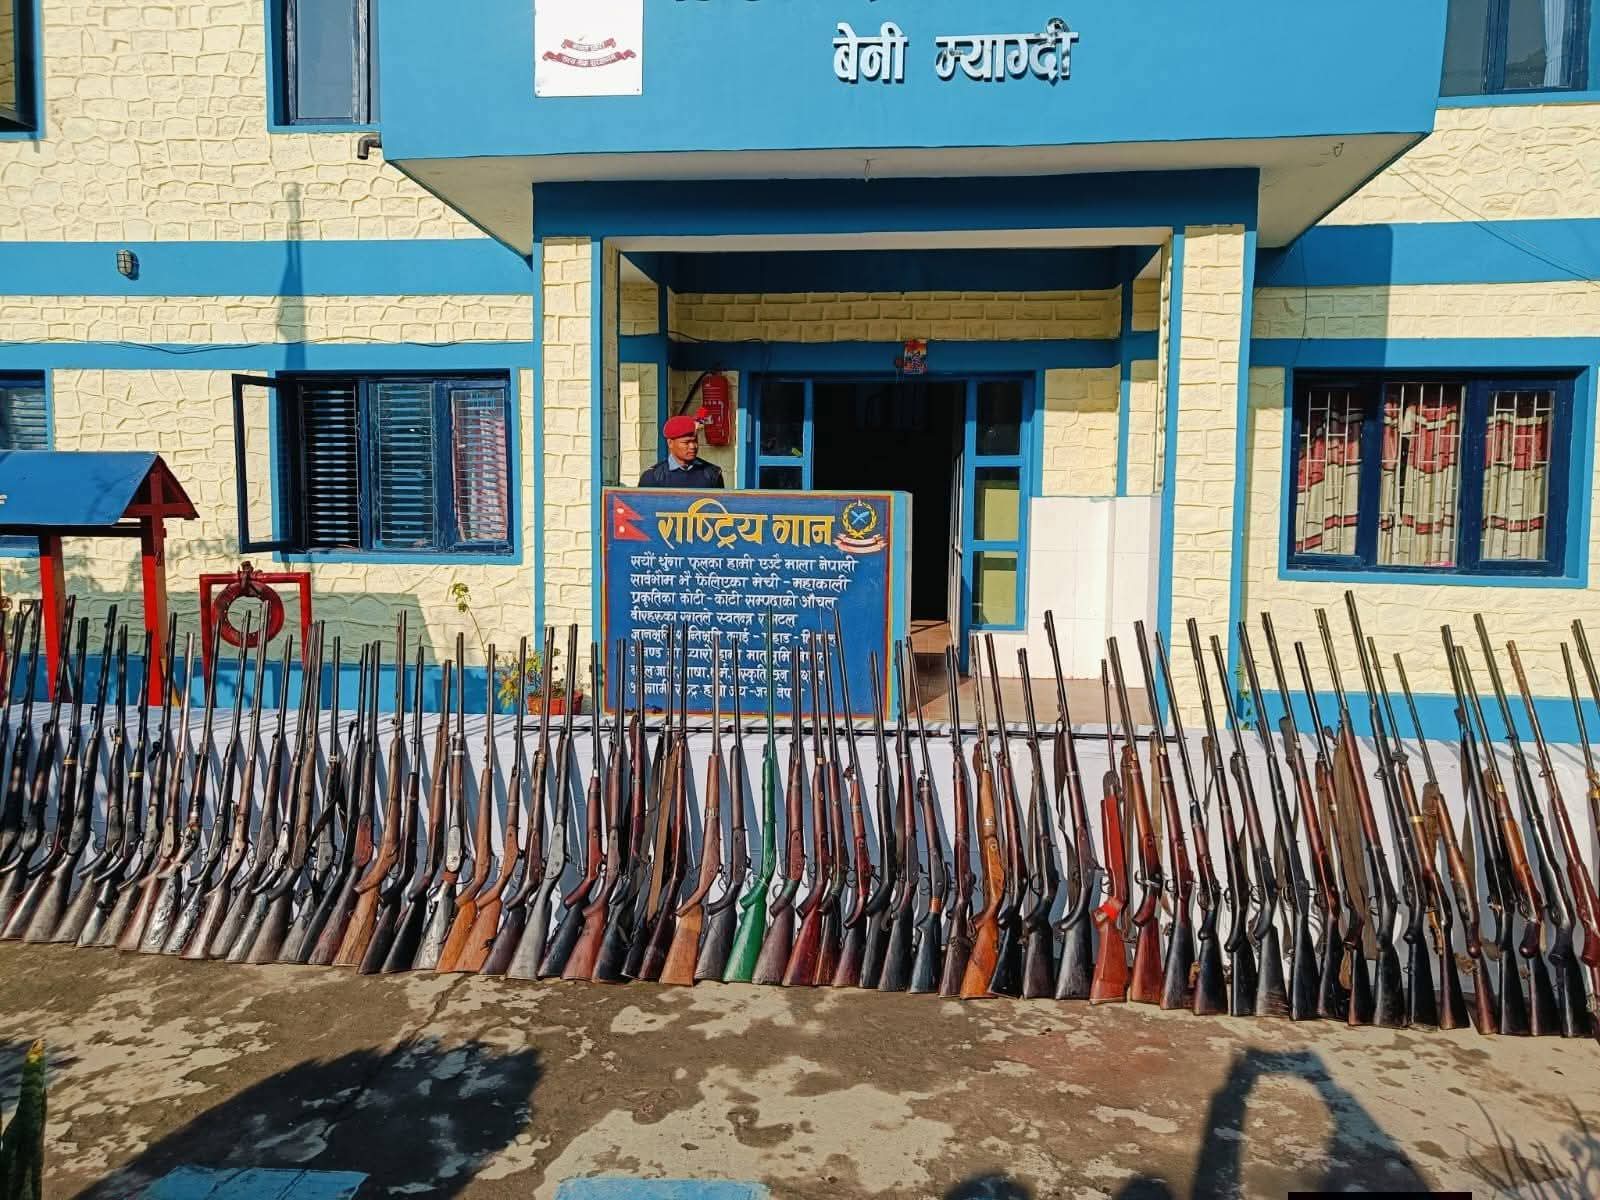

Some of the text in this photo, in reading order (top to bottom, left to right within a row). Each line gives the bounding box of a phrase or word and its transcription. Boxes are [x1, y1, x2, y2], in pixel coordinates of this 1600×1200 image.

[832, 17, 1079, 84] बेनी म्याग्दी
[656, 498, 768, 550] राष्ट्रिय
[772, 514, 835, 547] गान
[688, 557, 723, 573] फूलका
[726, 554, 755, 571] हामी
[758, 553, 783, 570] एउटै
[784, 559, 816, 574] माला
[818, 555, 859, 573] नेपाली
[630, 569, 677, 587] सार्वभौम
[679, 571, 693, 587] भै
[752, 573, 782, 589] मेची
[792, 575, 852, 593] महाकाली
[630, 588, 677, 607] प्रकृतिका
[680, 589, 706, 605] कोटी
[714, 590, 743, 607] कोटी
